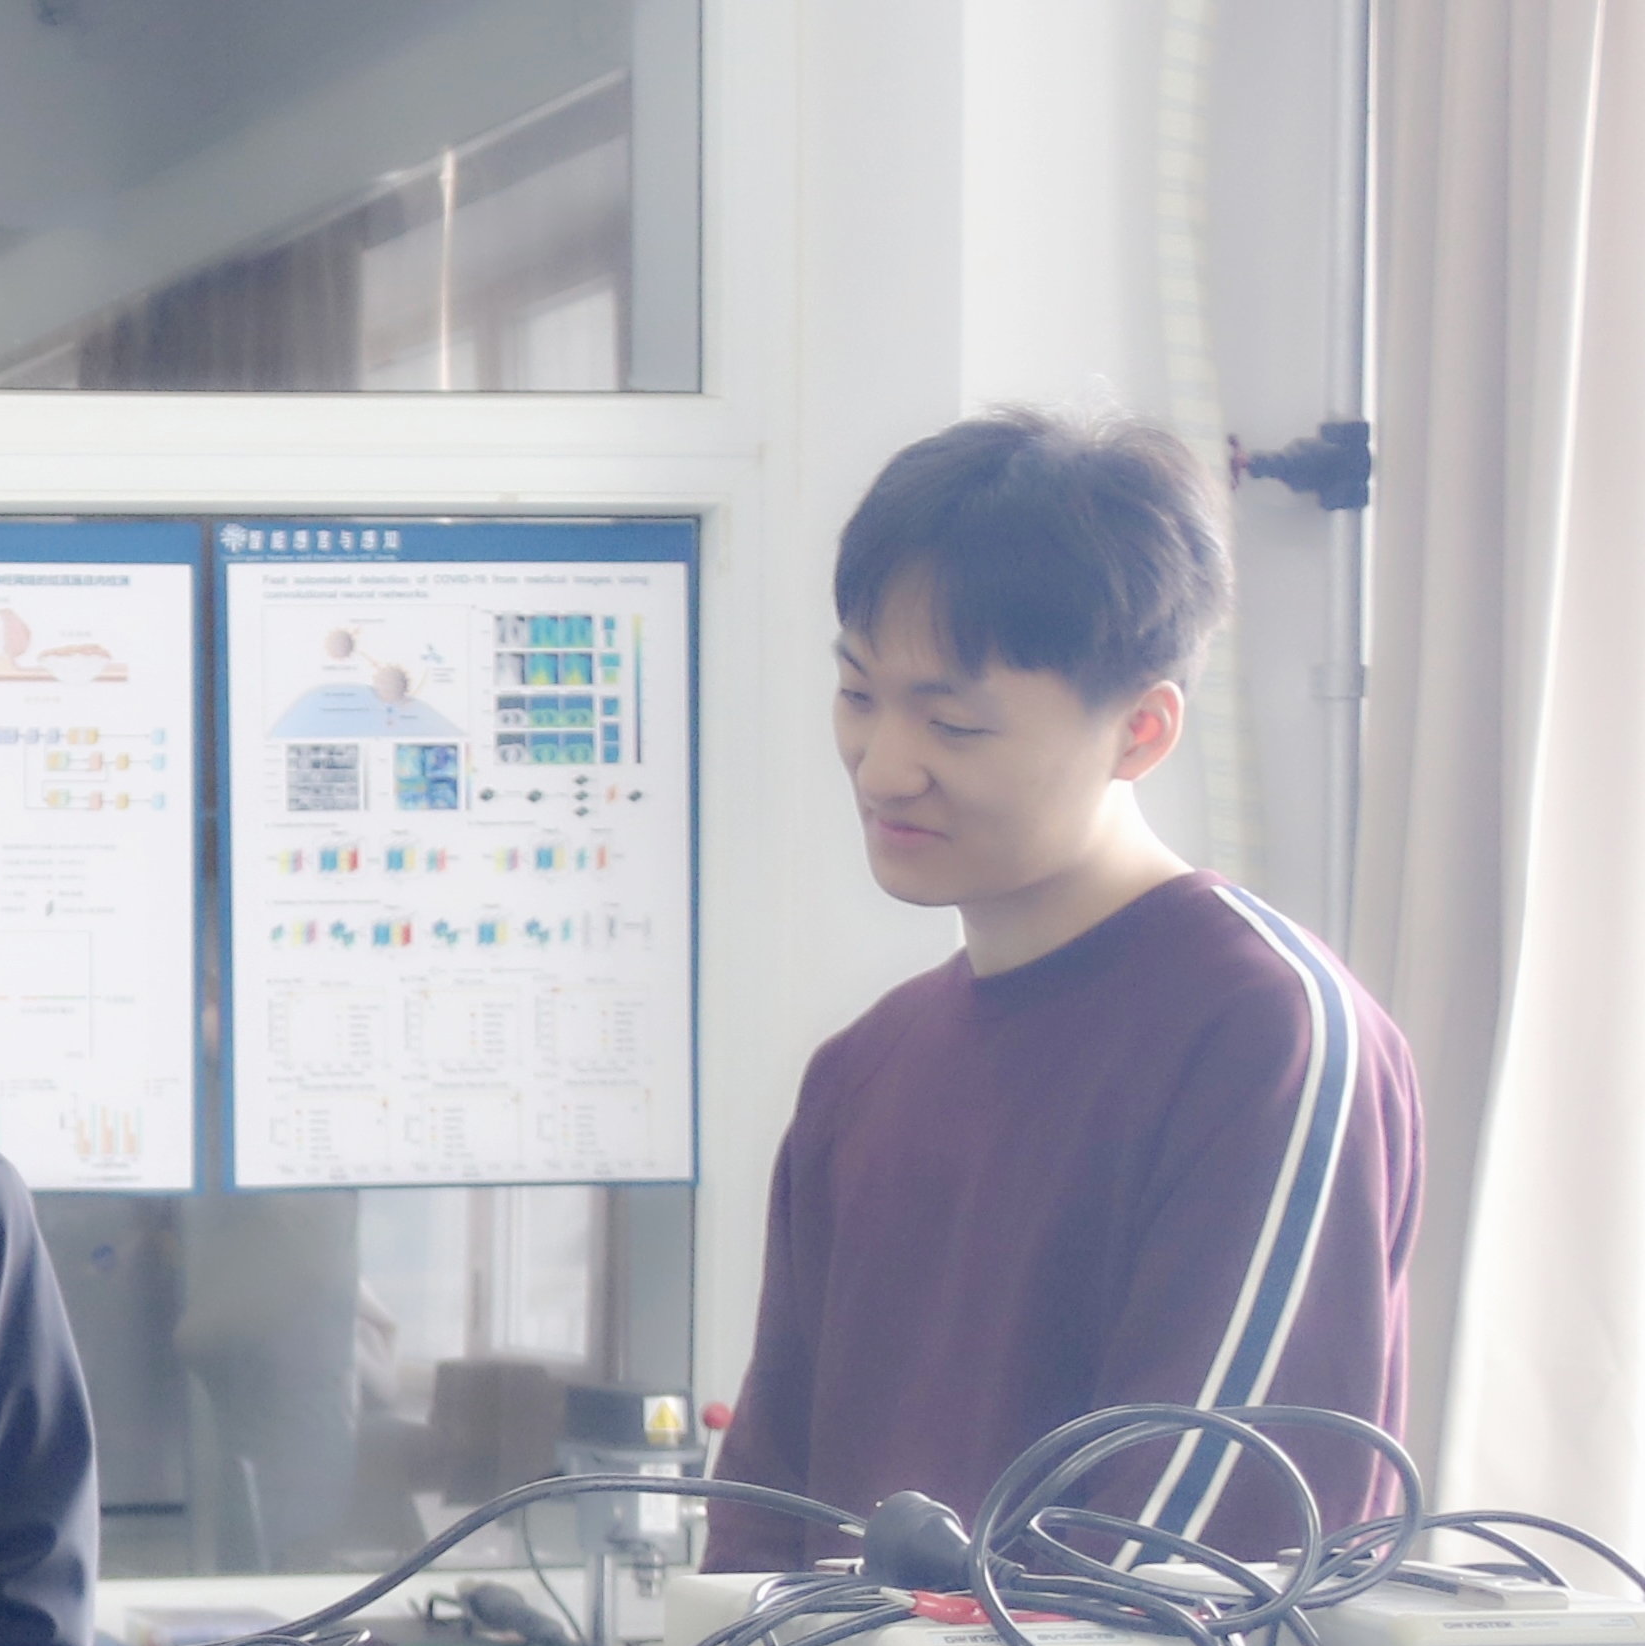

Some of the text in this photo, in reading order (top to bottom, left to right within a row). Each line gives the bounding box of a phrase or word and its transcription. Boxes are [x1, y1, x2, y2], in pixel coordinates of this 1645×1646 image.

[248, 529, 401, 551] 智能感官与感知
[293, 574, 352, 586] automated
[358, 574, 410, 586] detection
[525, 574, 567, 586] medical
